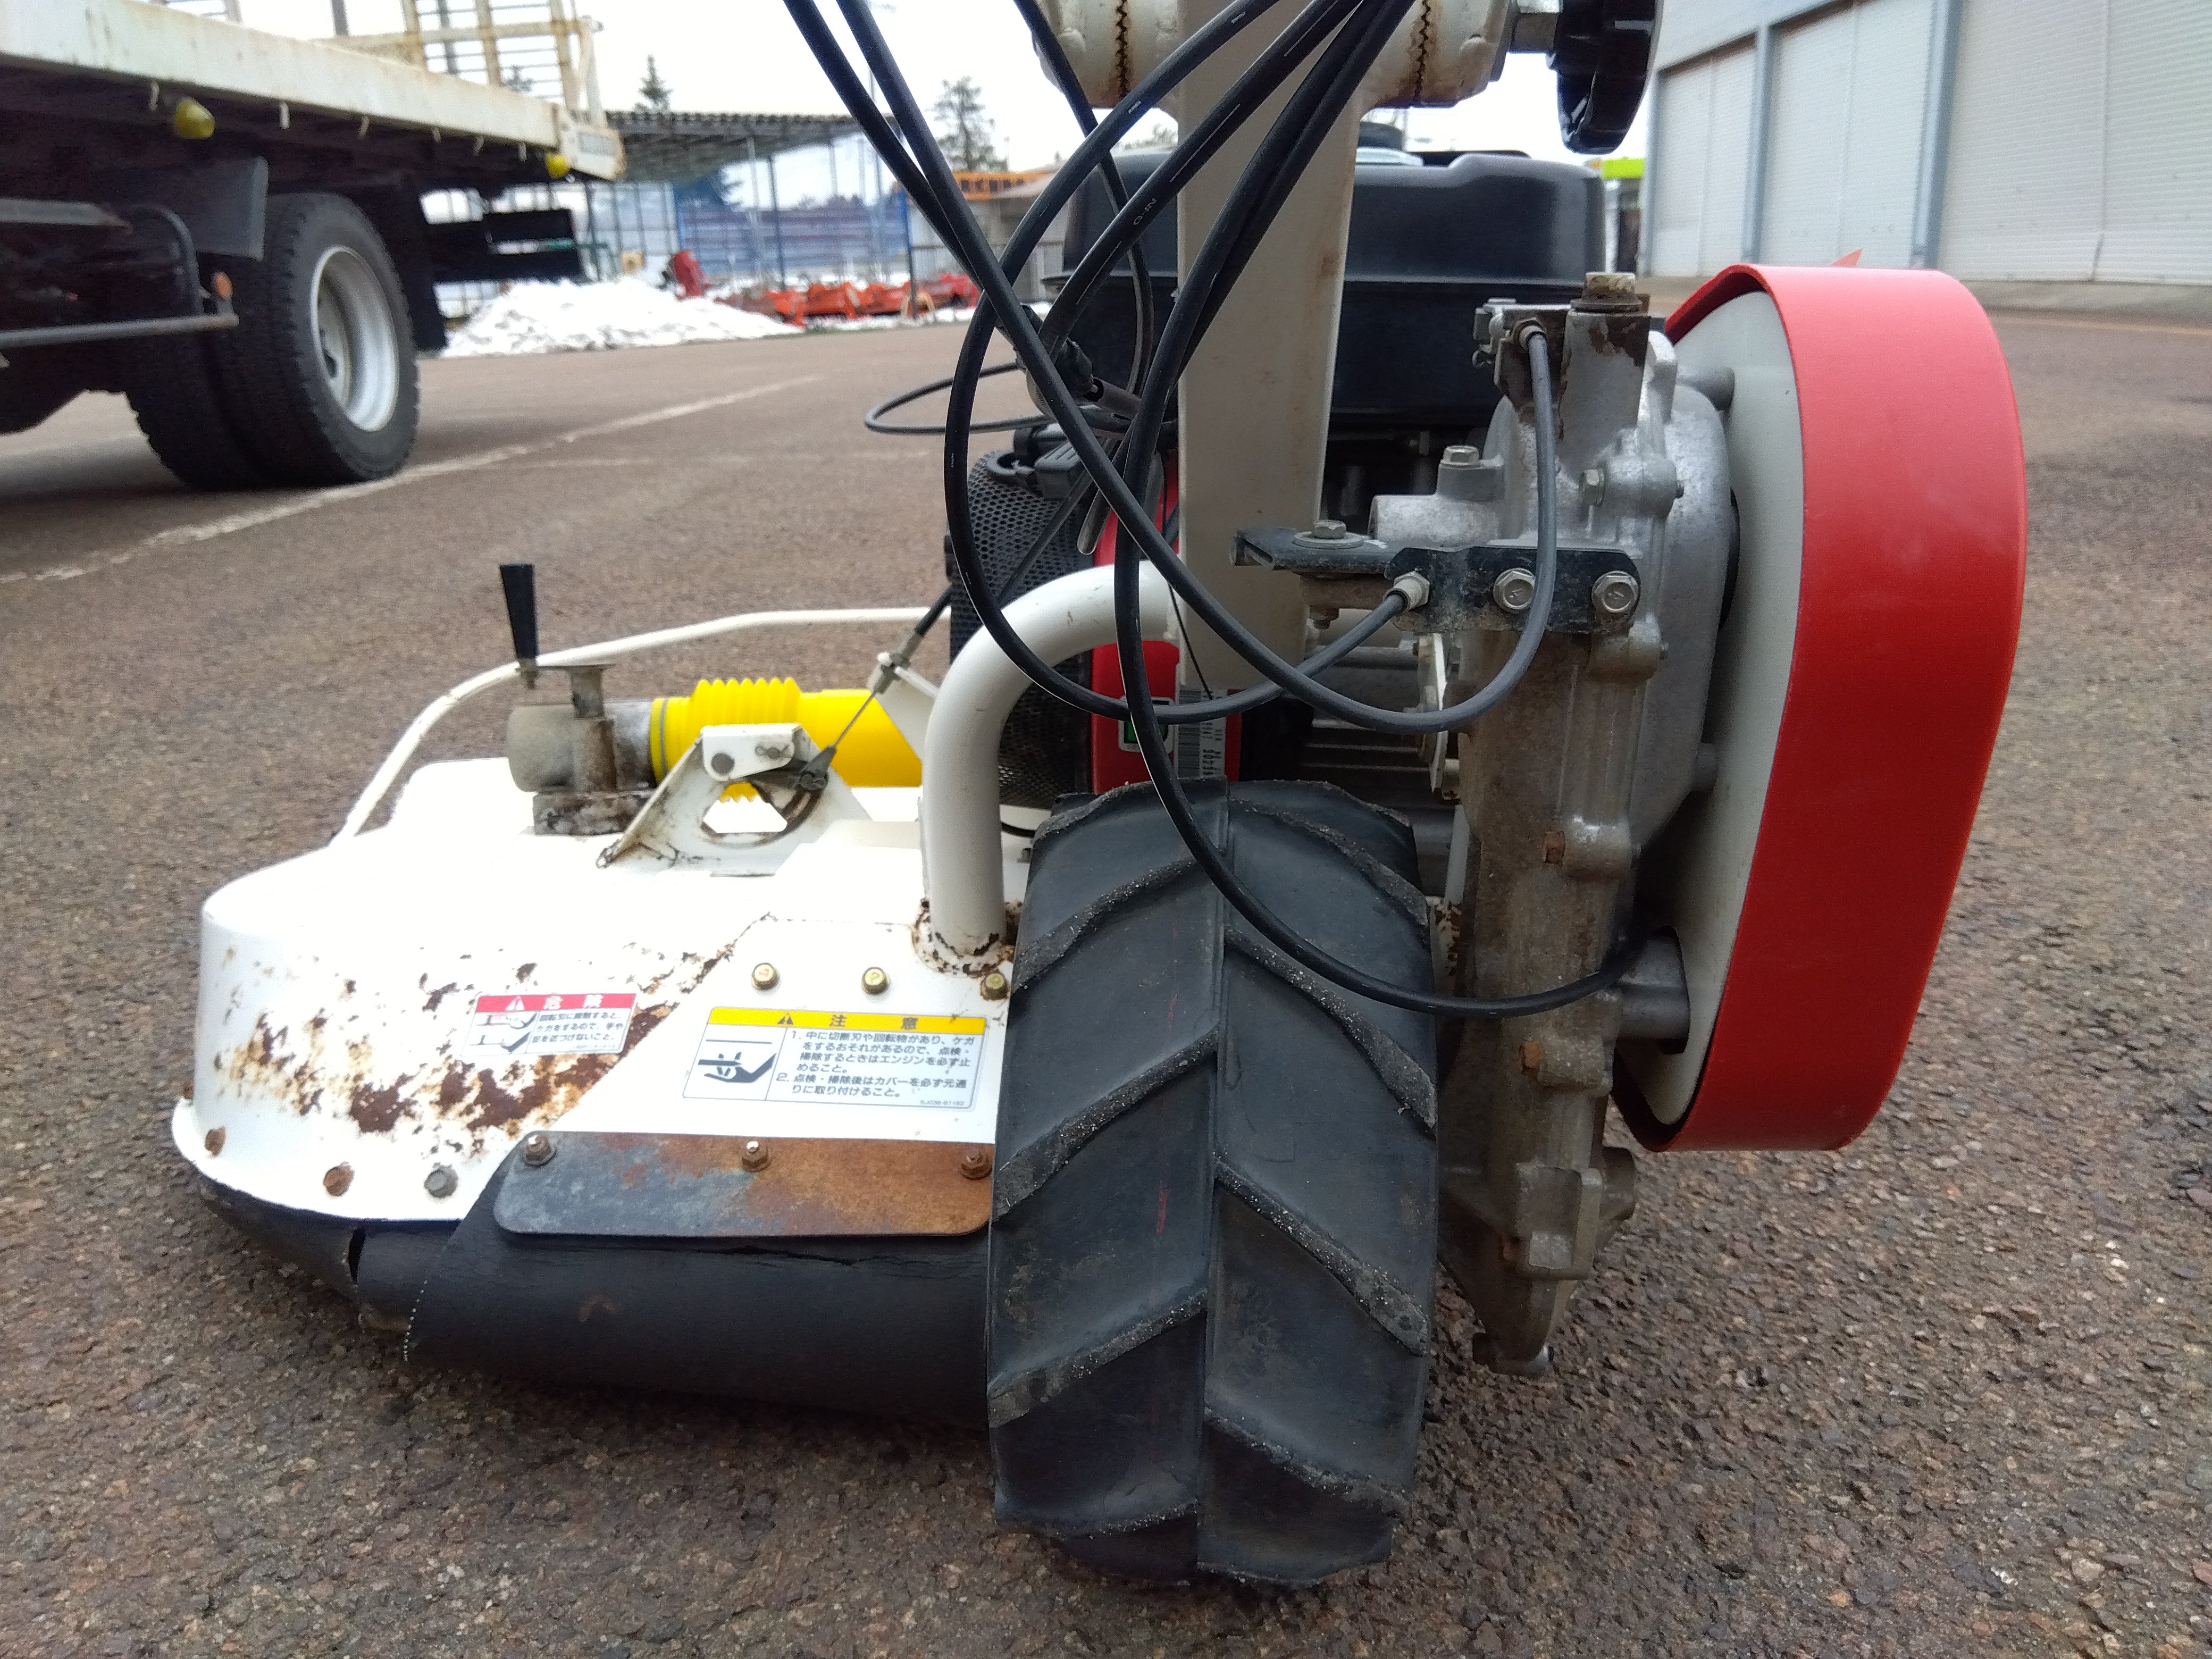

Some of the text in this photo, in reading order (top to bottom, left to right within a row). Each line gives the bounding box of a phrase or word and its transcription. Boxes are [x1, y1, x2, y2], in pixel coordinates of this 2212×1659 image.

[829, 1014, 919, 1030] 注意
[799, 1052, 971, 1068] 掃除するときはエンジンを必ず止
[797, 1063, 848, 1074] めること。
[792, 1084, 900, 1097] りに取り付けること。
